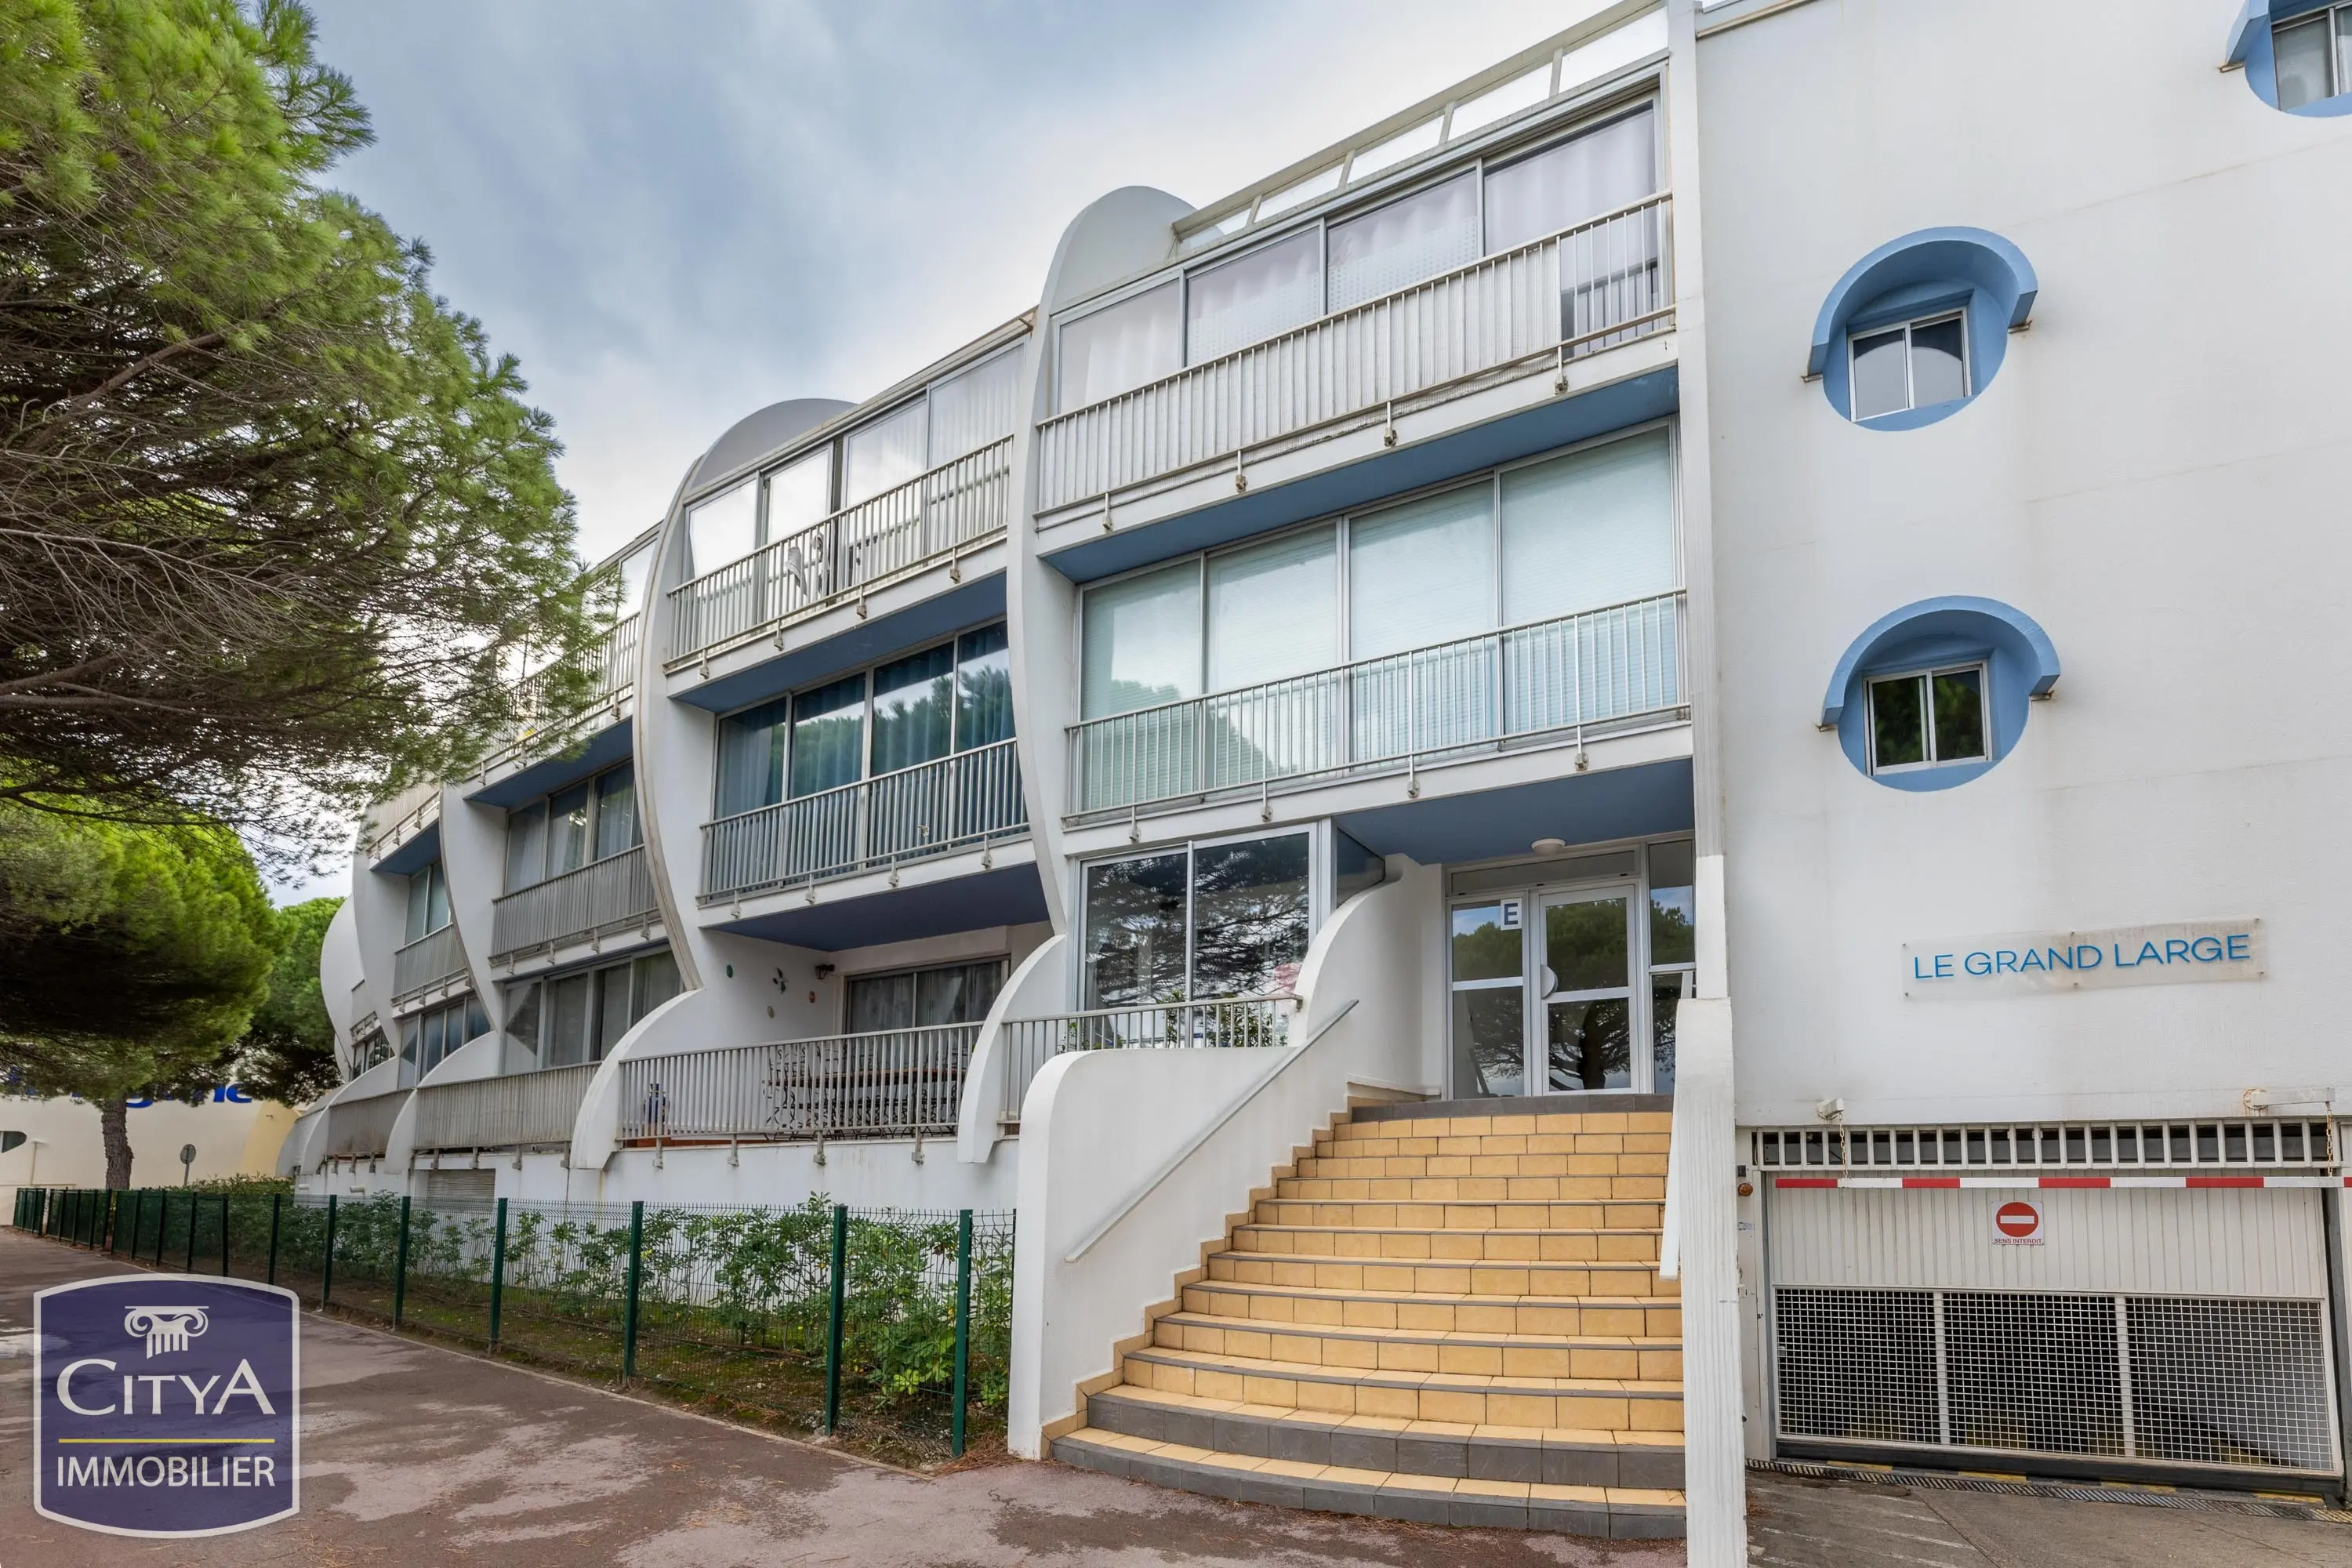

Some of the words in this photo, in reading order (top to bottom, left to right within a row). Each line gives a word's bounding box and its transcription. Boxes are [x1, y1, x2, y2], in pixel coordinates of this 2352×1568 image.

[1504, 902, 1519, 927] E
[1914, 953, 1955, 979] LE
[1964, 945, 2103, 975] GRAND
[2114, 934, 2251, 967] LARGE
